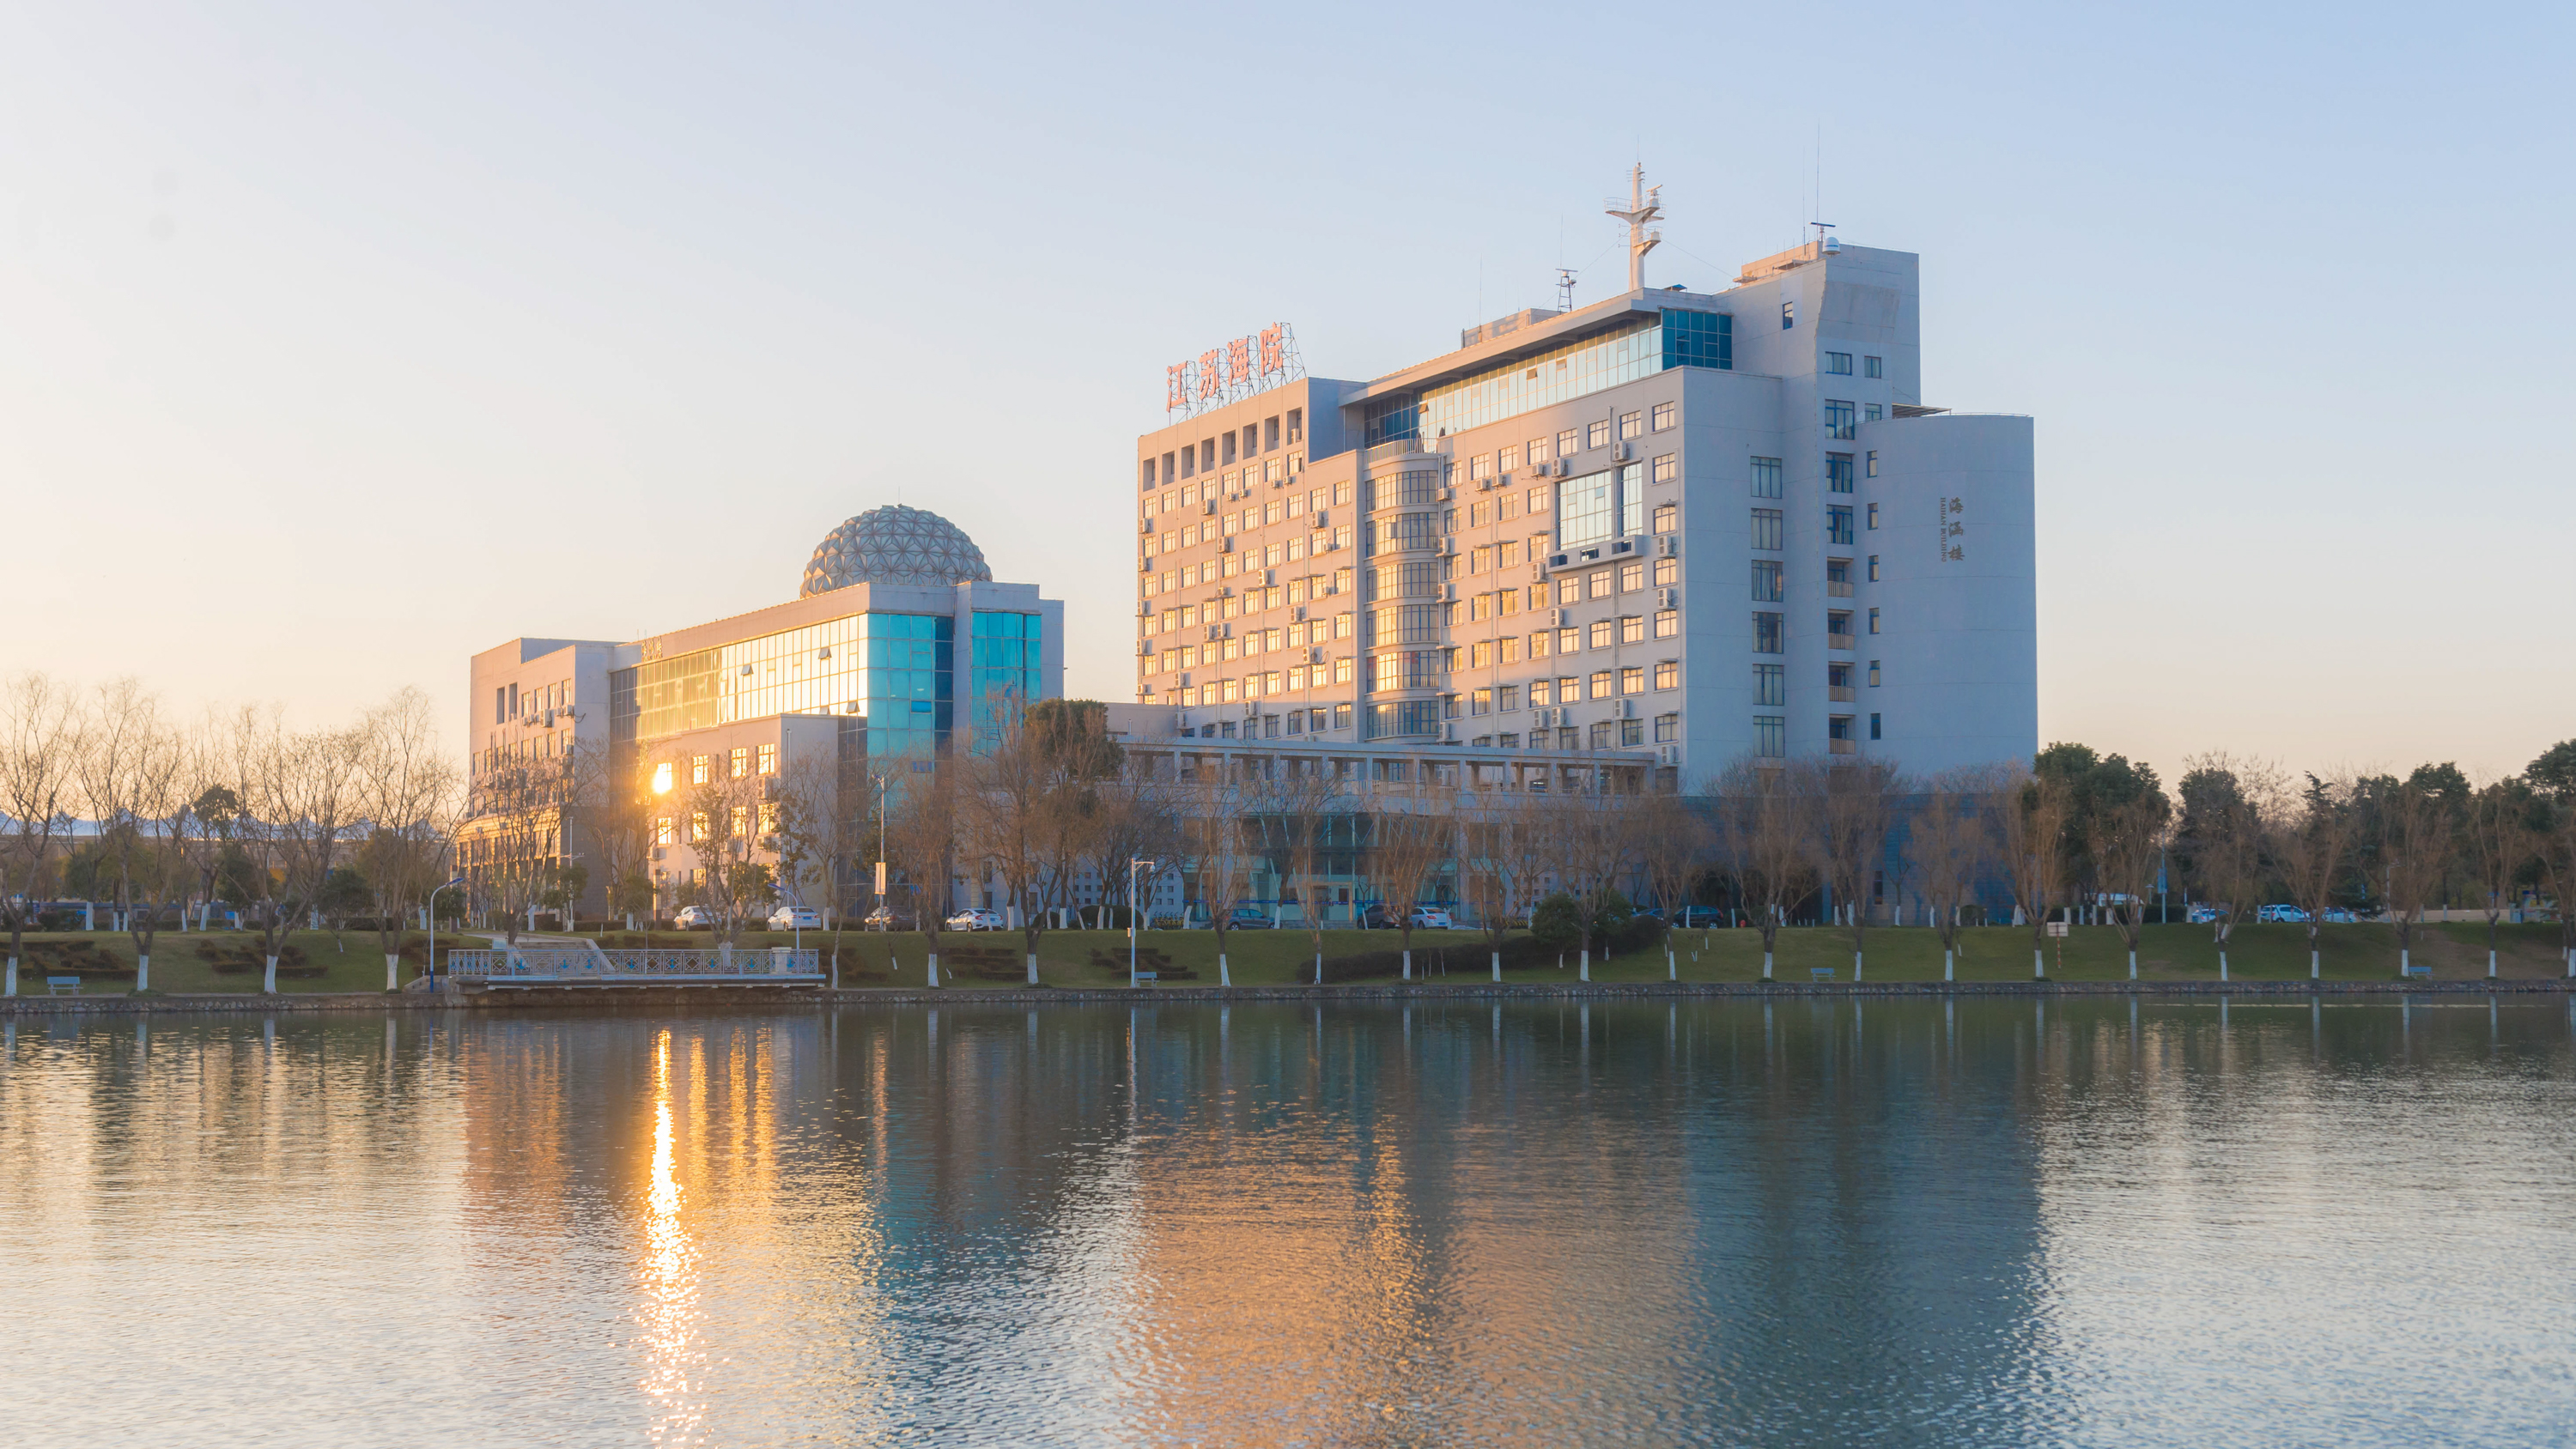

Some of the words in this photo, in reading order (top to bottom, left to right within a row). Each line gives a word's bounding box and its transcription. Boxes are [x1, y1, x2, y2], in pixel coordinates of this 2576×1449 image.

[1166, 322, 1283, 413] 江苏海院
[1947, 497, 1965, 561] 海涵楼
